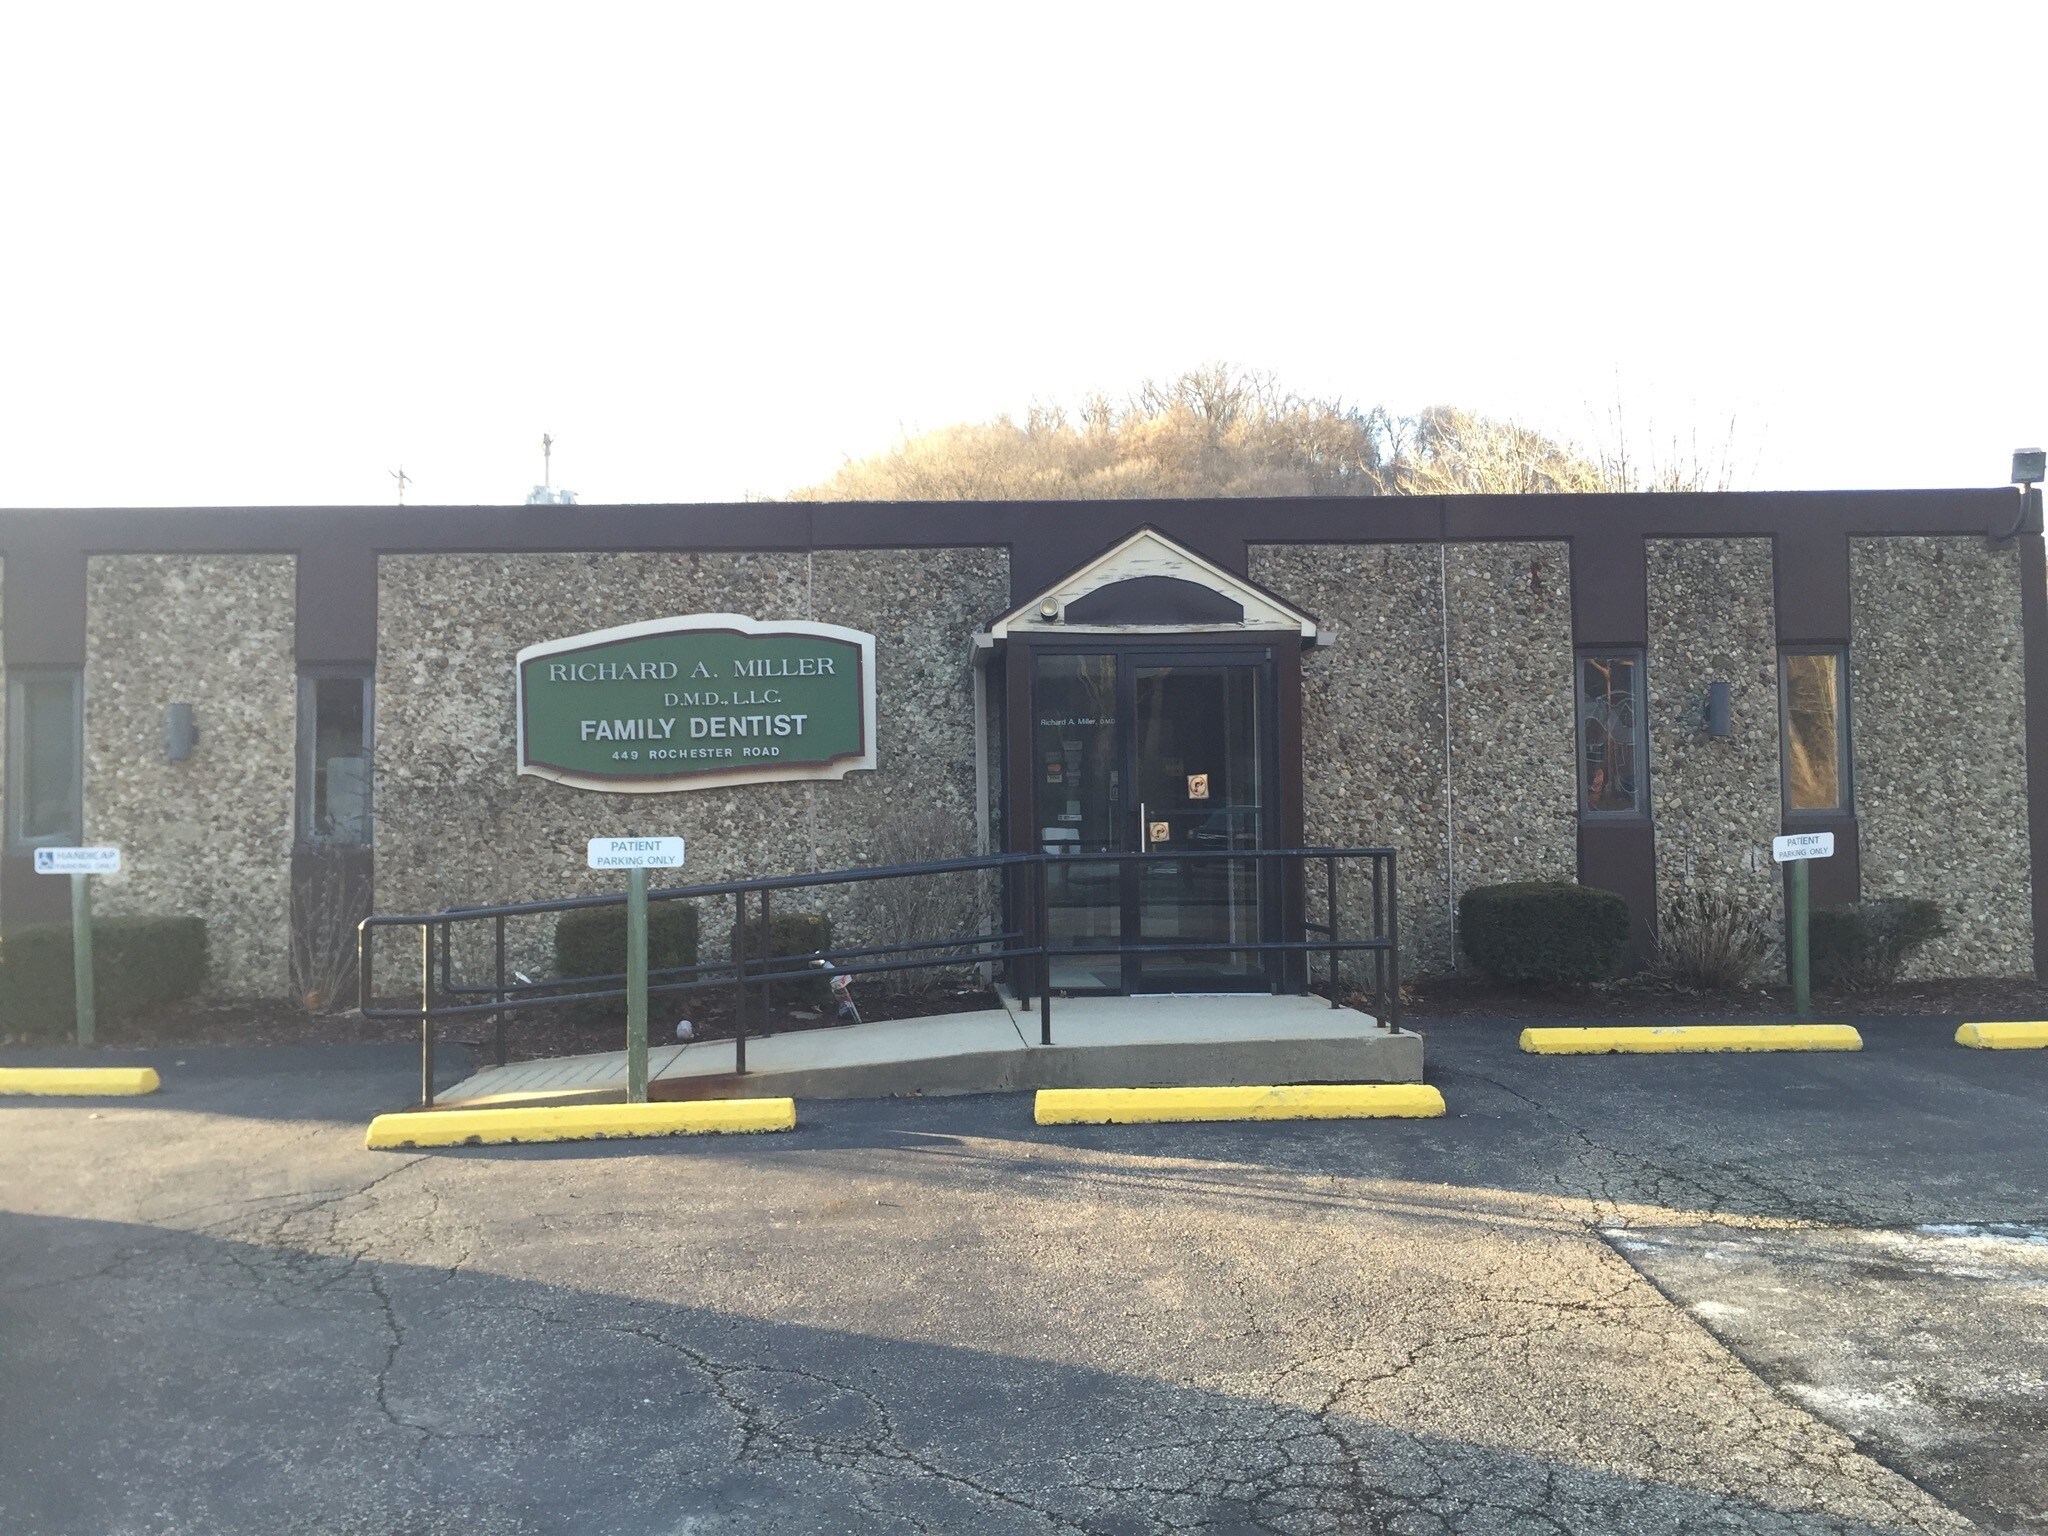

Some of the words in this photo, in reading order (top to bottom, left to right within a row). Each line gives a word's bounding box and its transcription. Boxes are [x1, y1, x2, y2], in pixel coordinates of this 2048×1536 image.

[549, 661, 678, 682] RICHARD
[690, 661, 718, 679] A.
[733, 657, 836, 678] MILLER
[733, 689, 782, 705] L.L.C.
[580, 717, 676, 741] FAMILY
[690, 714, 808, 738] DENTIST
[1040, 718, 1067, 726] Richard
[611, 750, 639, 761] 449
[649, 748, 733, 760] ROCHESTER
[743, 747, 780, 757] ROAD
[611, 840, 662, 852] PATIENT
[1787, 836, 1820, 847] PATIENT
[1778, 848, 1807, 859] PARKING
[1809, 847, 1829, 856] ONLY
[597, 856, 644, 866] PARKING
[647, 855, 676, 865] ONLY
